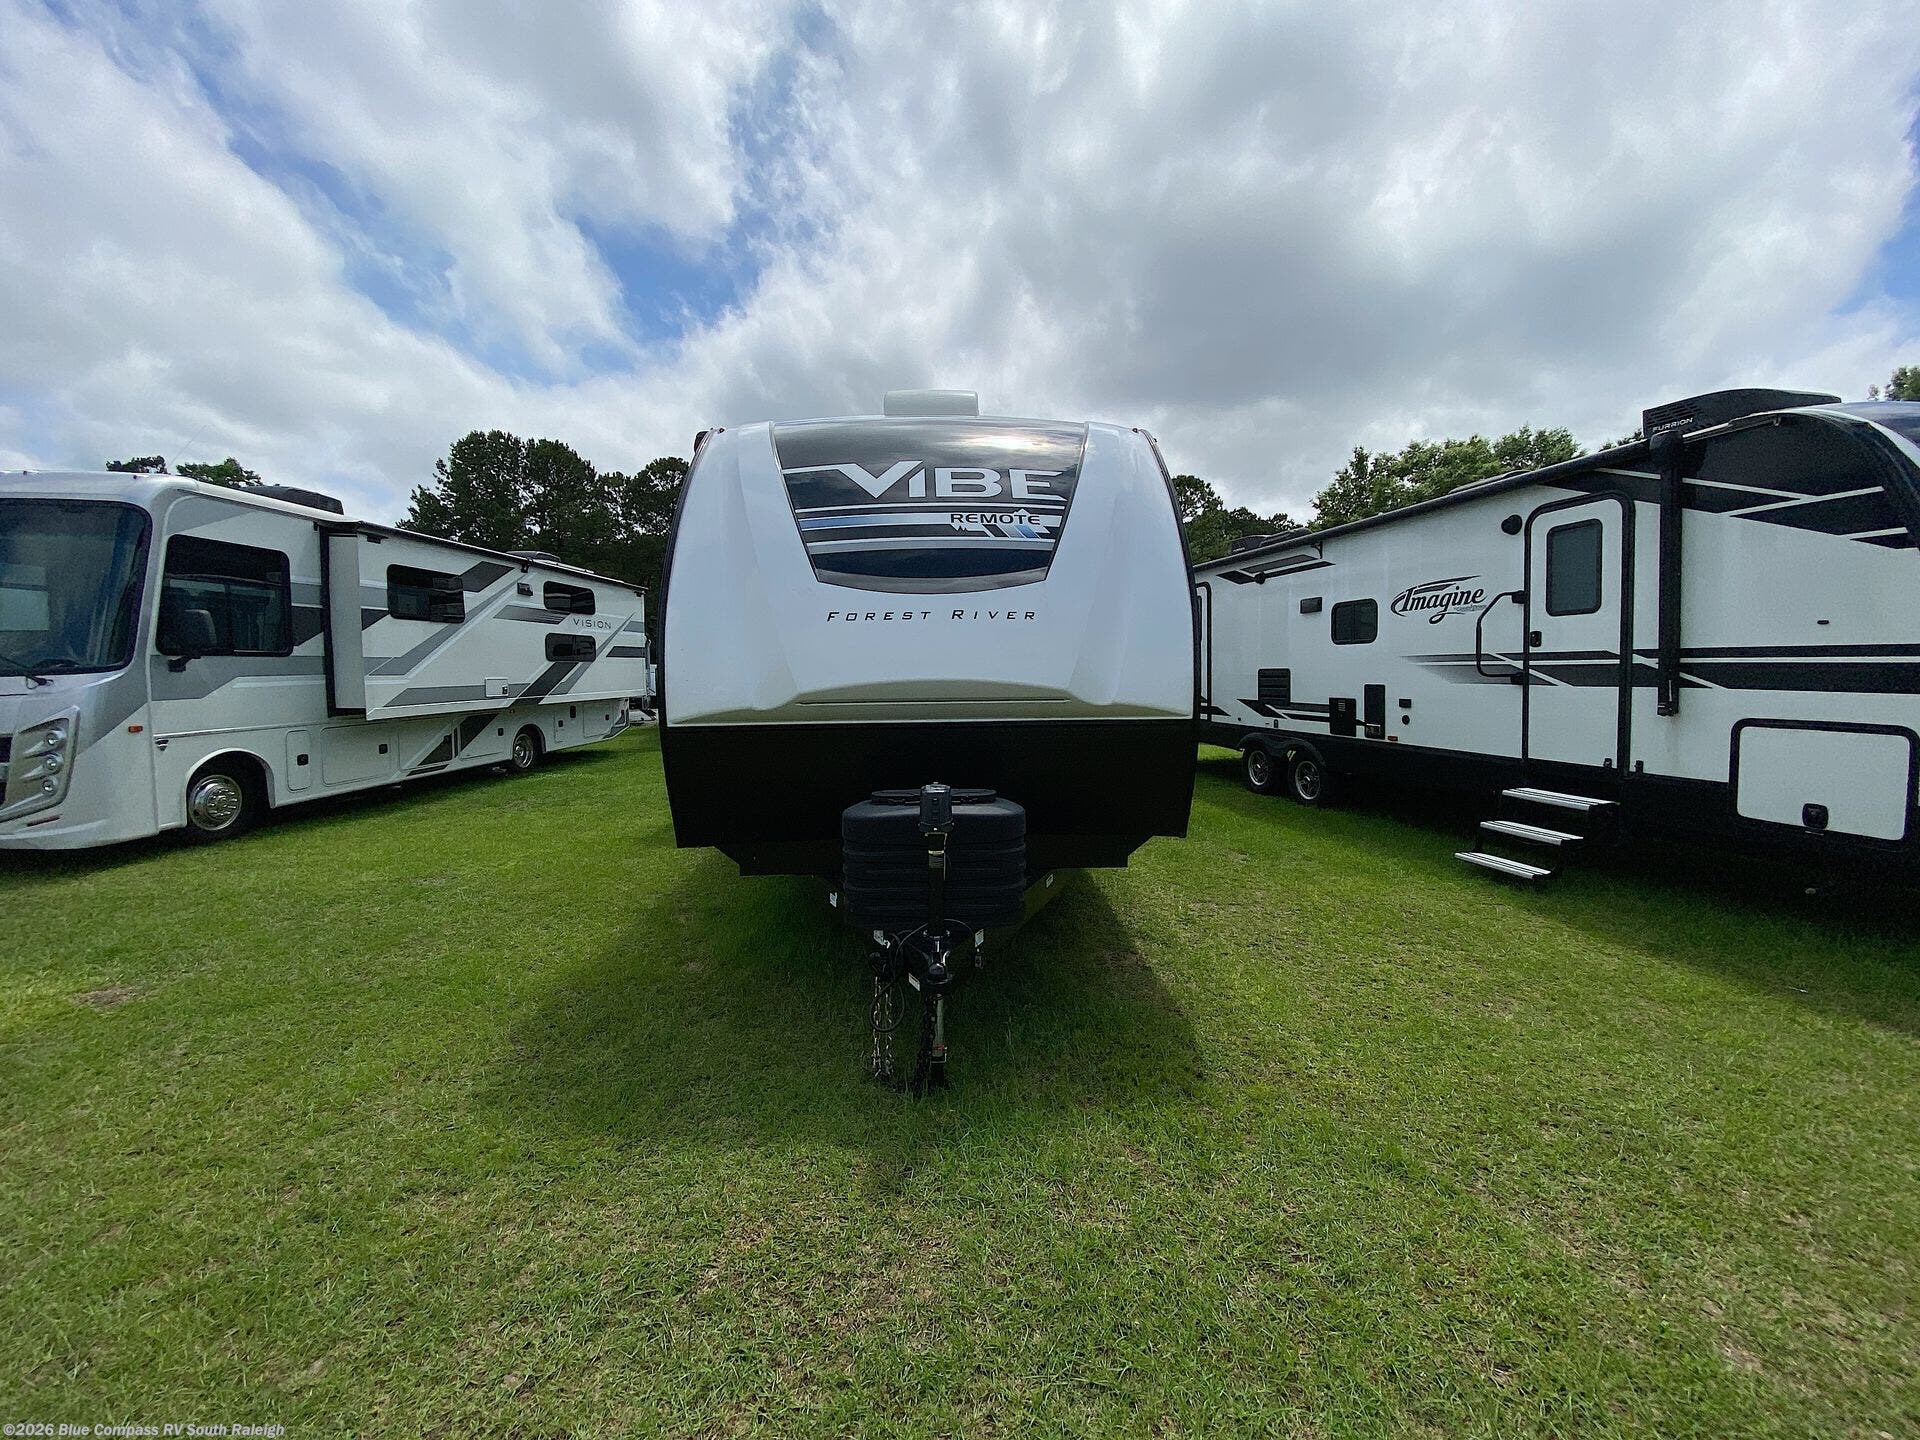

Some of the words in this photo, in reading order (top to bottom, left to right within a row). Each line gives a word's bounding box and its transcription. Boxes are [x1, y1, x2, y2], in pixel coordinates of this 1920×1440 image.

[1652, 417, 1693, 432] FURRION
[837, 460, 1068, 501] VIBE
[950, 511, 1041, 525] REMOTE
[1398, 585, 1487, 624] Imagine
[827, 611, 931, 621] FOREST
[951, 609, 1035, 620] RIVER
[573, 618, 612, 629] VISION
